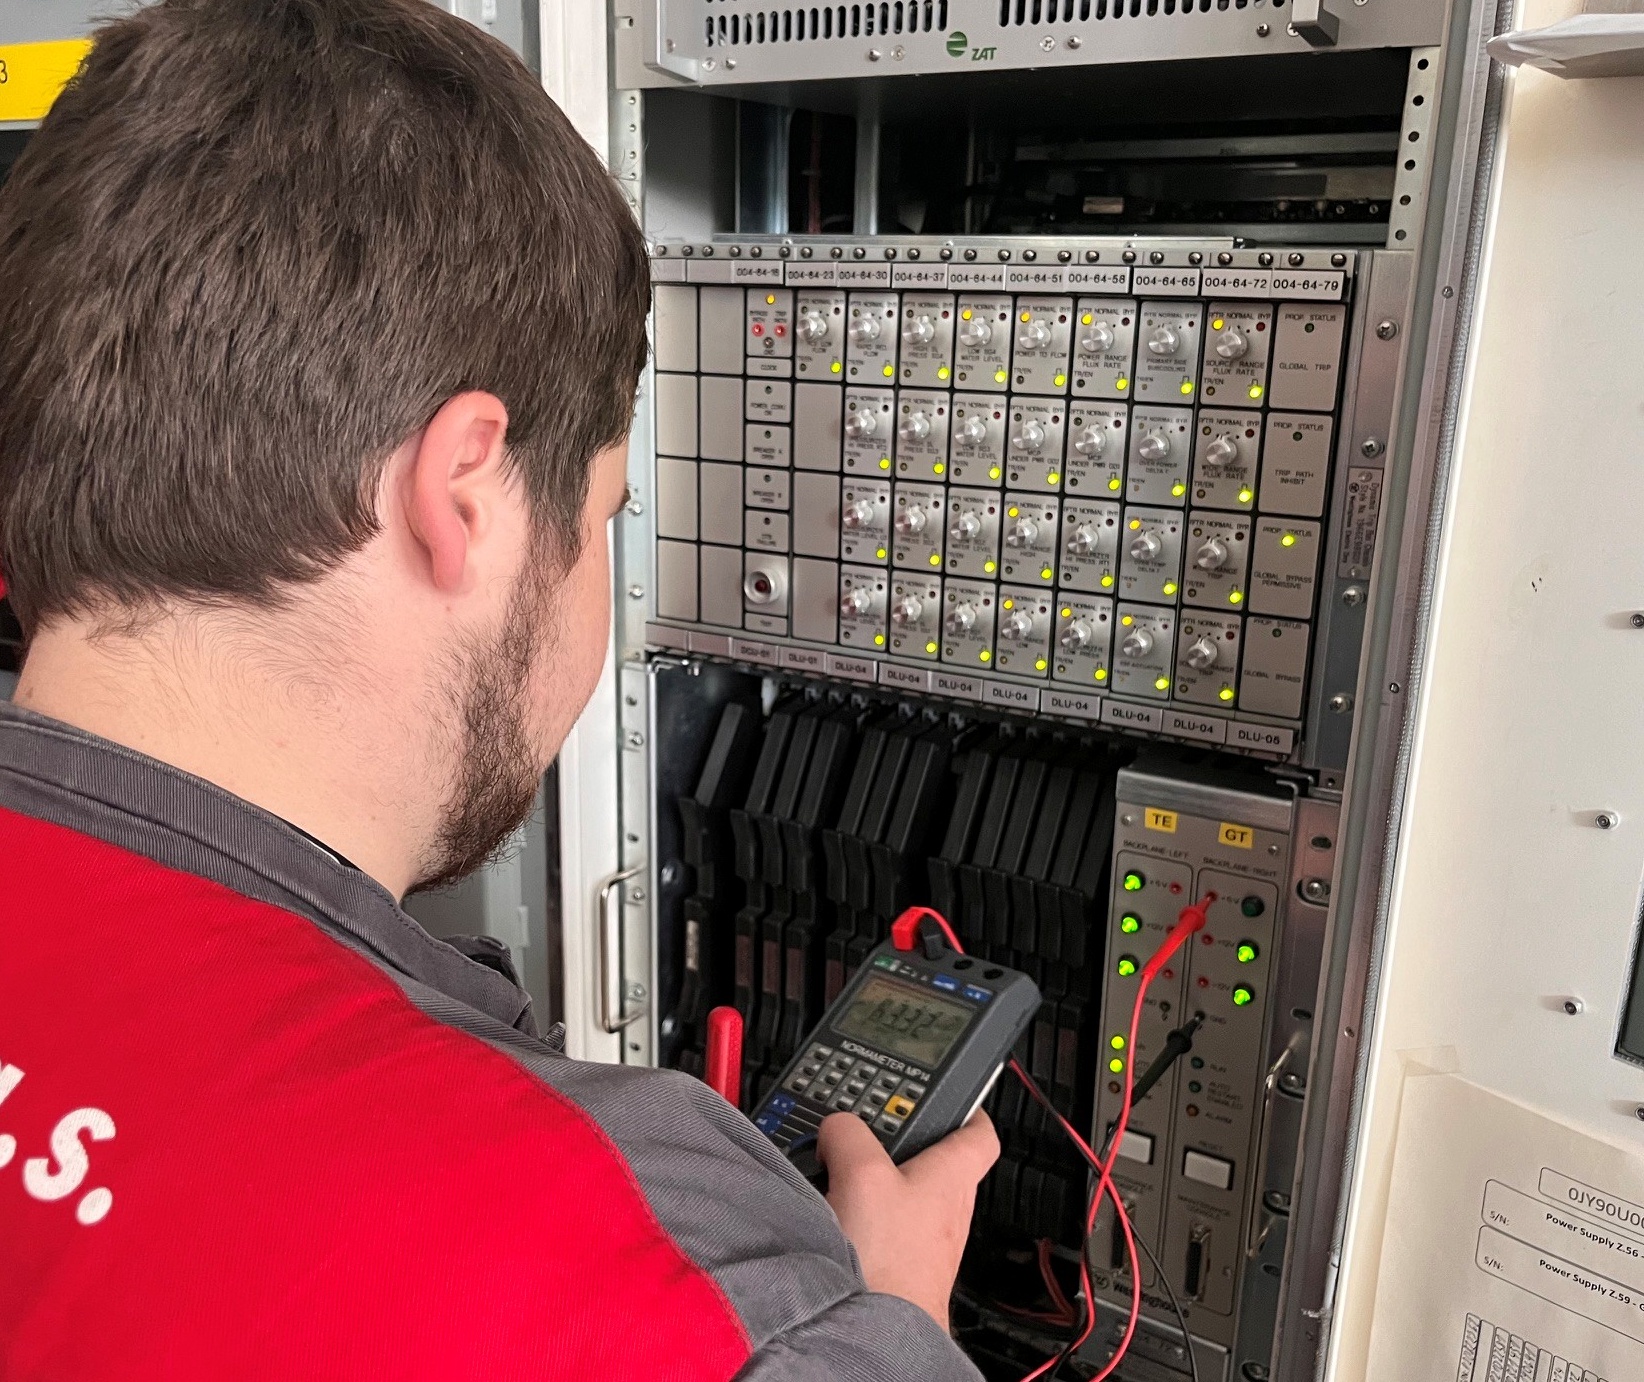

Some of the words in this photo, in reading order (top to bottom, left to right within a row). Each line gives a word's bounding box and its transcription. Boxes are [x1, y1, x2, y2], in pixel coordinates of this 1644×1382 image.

[972, 48, 997, 60] ZAT
[788, 271, 834, 279] 004-64-23
[839, 272, 887, 280] 004-64-30
[895, 273, 944, 281] 004-64-37
[1010, 274, 1062, 282] 004-64-51
[1069, 273, 1125, 283] 004-64-58
[1136, 276, 1195, 286] 004-64-65
[1205, 278, 1267, 288] 004-64-72
[1274, 279, 1339, 291] 004-64-79
[1104, 361, 1121, 369] RATE
[1217, 418, 1243, 426] NORMAL
[1207, 520, 1233, 529] NORMAL
[1254, 572, 1279, 580] GLOBAL
[1286, 574, 1312, 583] BYPASS
[888, 670, 920, 683] DLU-04
[939, 680, 972, 691] DLU-04
[993, 688, 1027, 700] DLU-04
[1052, 698, 1088, 710] DLU-04
[1112, 708, 1150, 722] DLU-04
[1174, 719, 1213, 733] DLU-04
[1152, 813, 1172, 828] TE
[1225, 828, 1247, 843] GT
[841, 1040, 904, 1069] NORMAMETER
[1546, 1213, 1578, 1232] Power
[1580, 1227, 1614, 1249] Supply
[1617, 1243, 1639, 1257] Z.56
[1540, 1259, 1571, 1278] Power
[1573, 1274, 1607, 1296] Supply
[1609, 1289, 1631, 1304] Z.59
